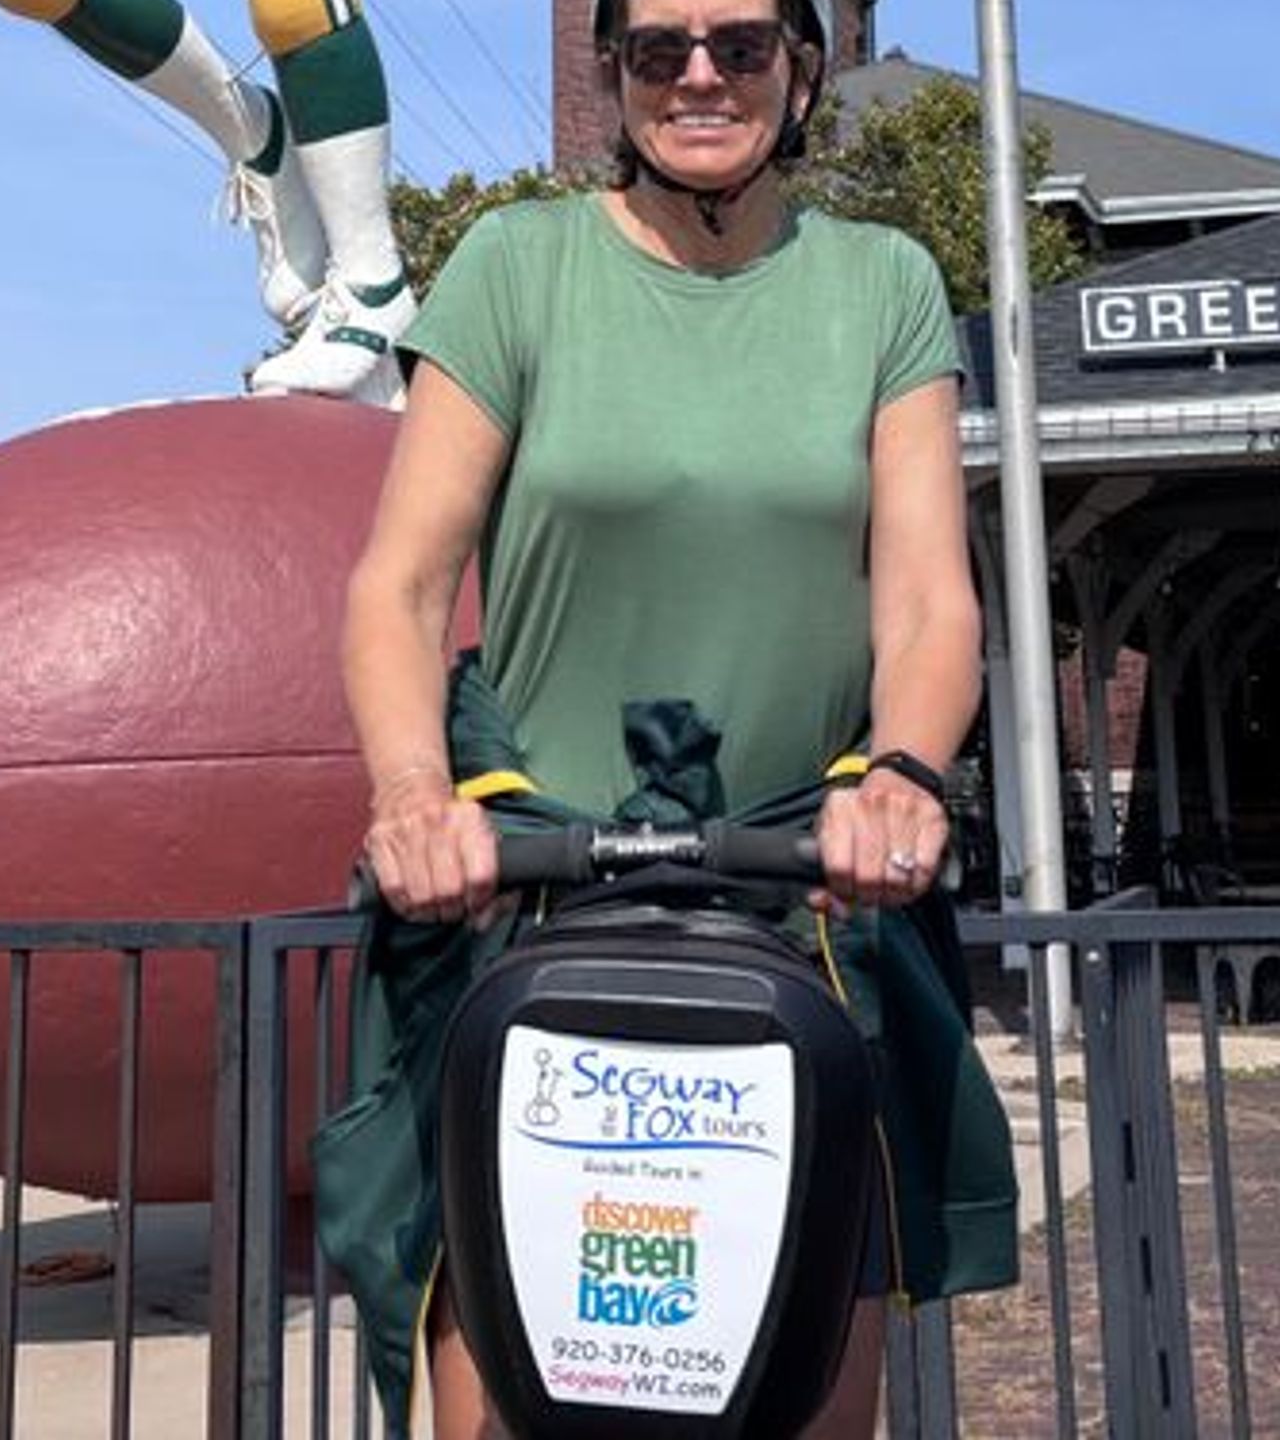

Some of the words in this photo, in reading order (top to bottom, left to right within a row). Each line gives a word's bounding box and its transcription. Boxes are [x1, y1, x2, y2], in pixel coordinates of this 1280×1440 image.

[703, 1115, 767, 1139] tours
[582, 1191, 698, 1233] discover
[580, 1231, 696, 1280] green
[578, 1273, 651, 1328] bay
[551, 1336, 727, 1374] 920-376-0256
[548, 1364, 722, 1398] SegwayWI.com
